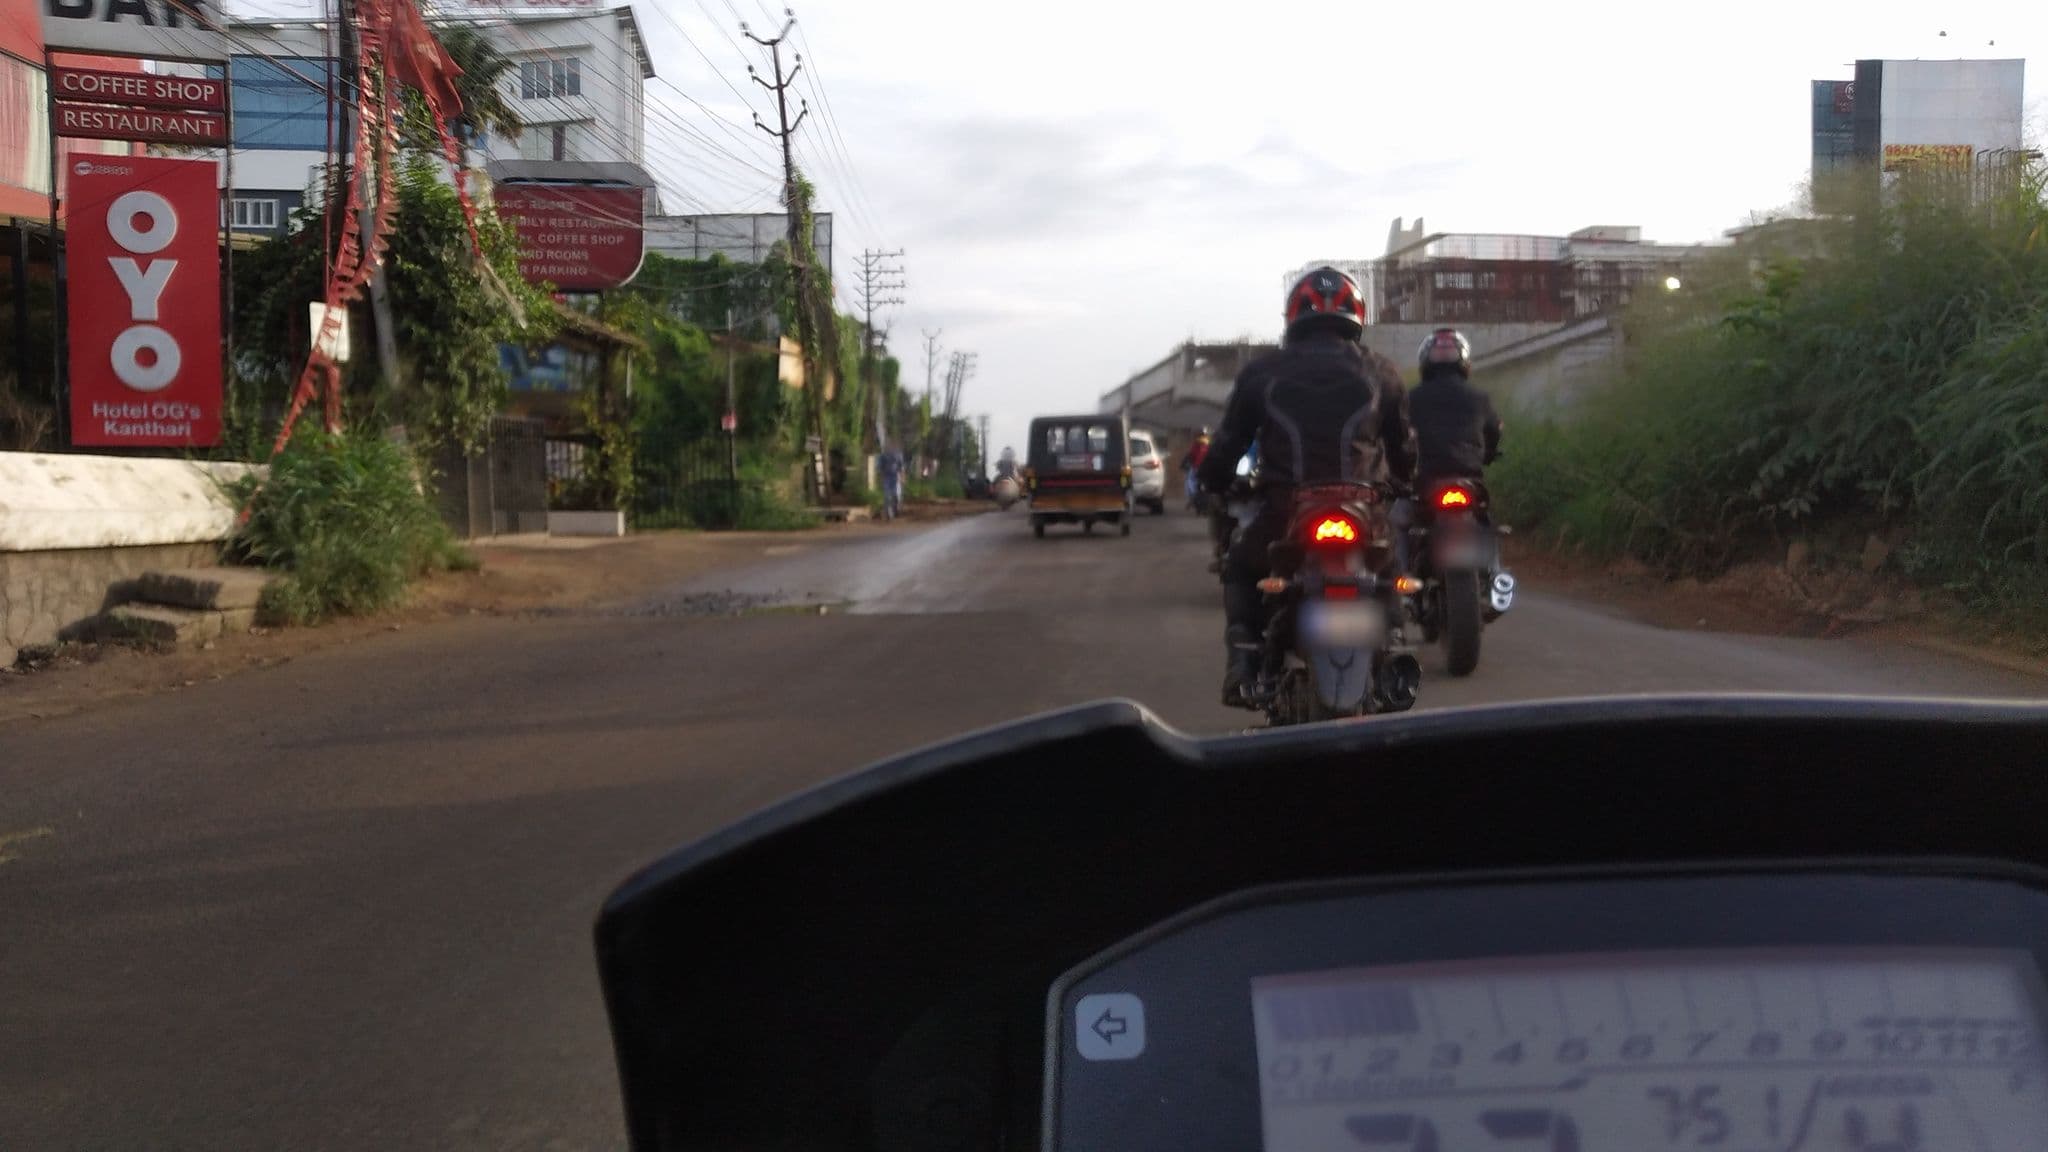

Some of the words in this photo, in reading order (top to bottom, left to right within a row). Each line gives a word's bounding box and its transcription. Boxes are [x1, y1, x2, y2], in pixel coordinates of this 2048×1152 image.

[62, 73, 147, 96] COFFEE
[154, 80, 215, 101] SHOP
[63, 110, 215, 136] RESTAURANT
[537, 233, 587, 244] COFFEE
[591, 234, 625, 245] SHOP
[546, 249, 589, 261] ROOMS
[107, 190, 181, 391] OYO
[92, 400, 147, 418] Hotel
[152, 402, 201, 420] OG's
[104, 420, 192, 437] Kanthari
[1491, 1040, 1524, 1066] 4
